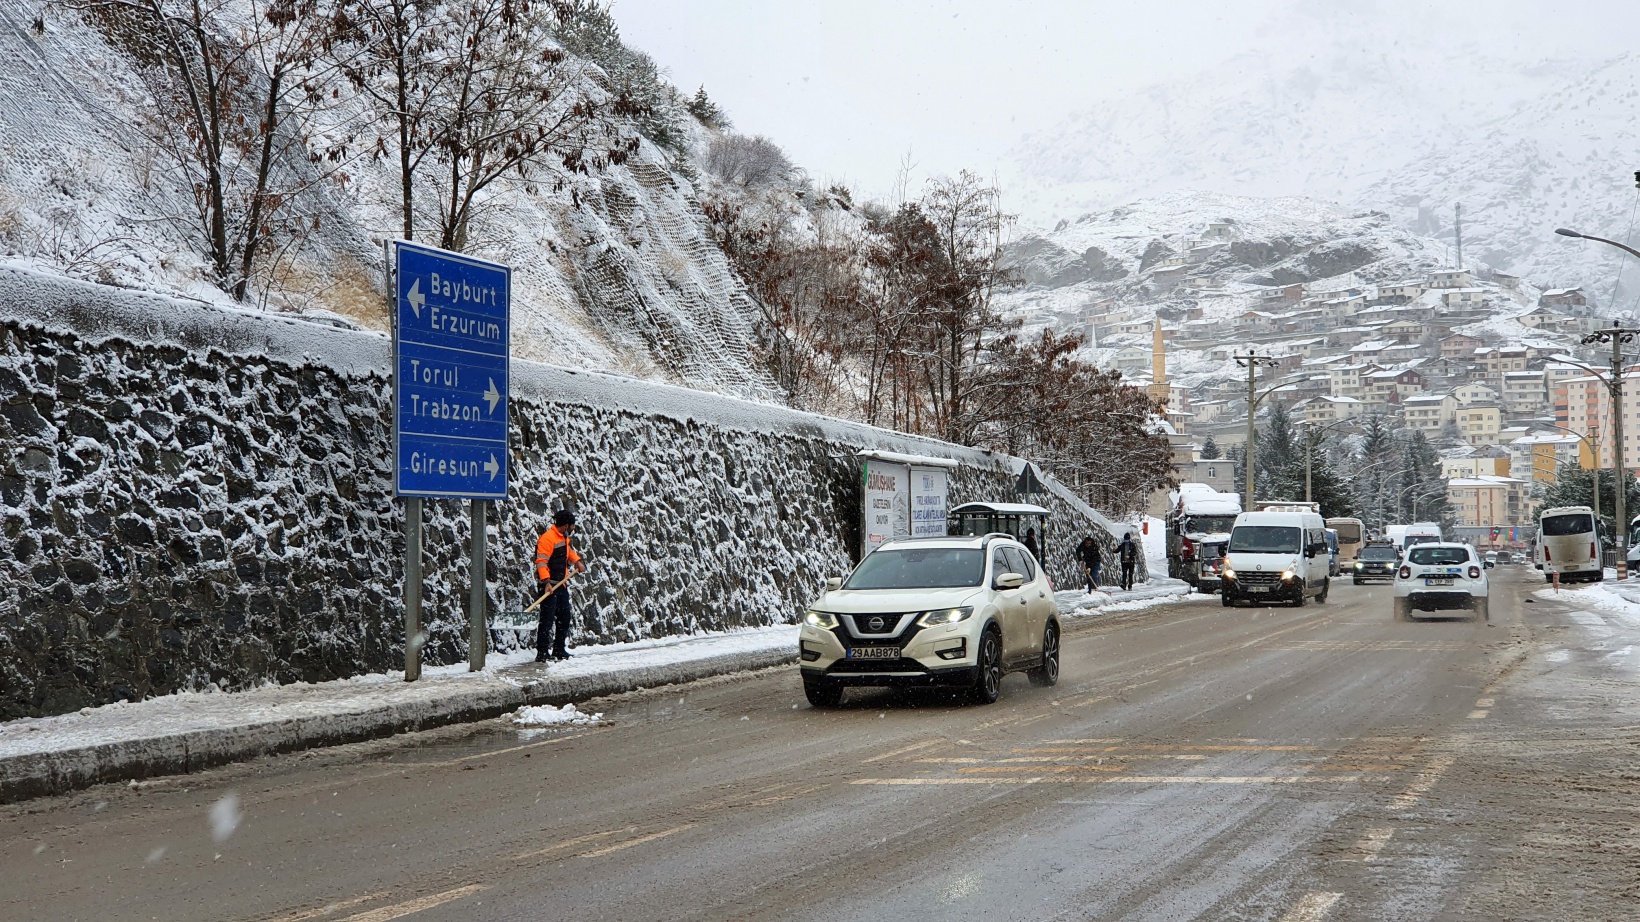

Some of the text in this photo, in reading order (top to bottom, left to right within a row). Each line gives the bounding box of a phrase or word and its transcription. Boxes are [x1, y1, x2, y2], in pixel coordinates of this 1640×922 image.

[431, 272, 496, 307] Bayburt
[431, 307, 500, 340] Erzurum
[411, 359, 458, 388] Torul
[411, 394, 481, 422] Trabzon
[411, 451, 478, 477] Giresun
